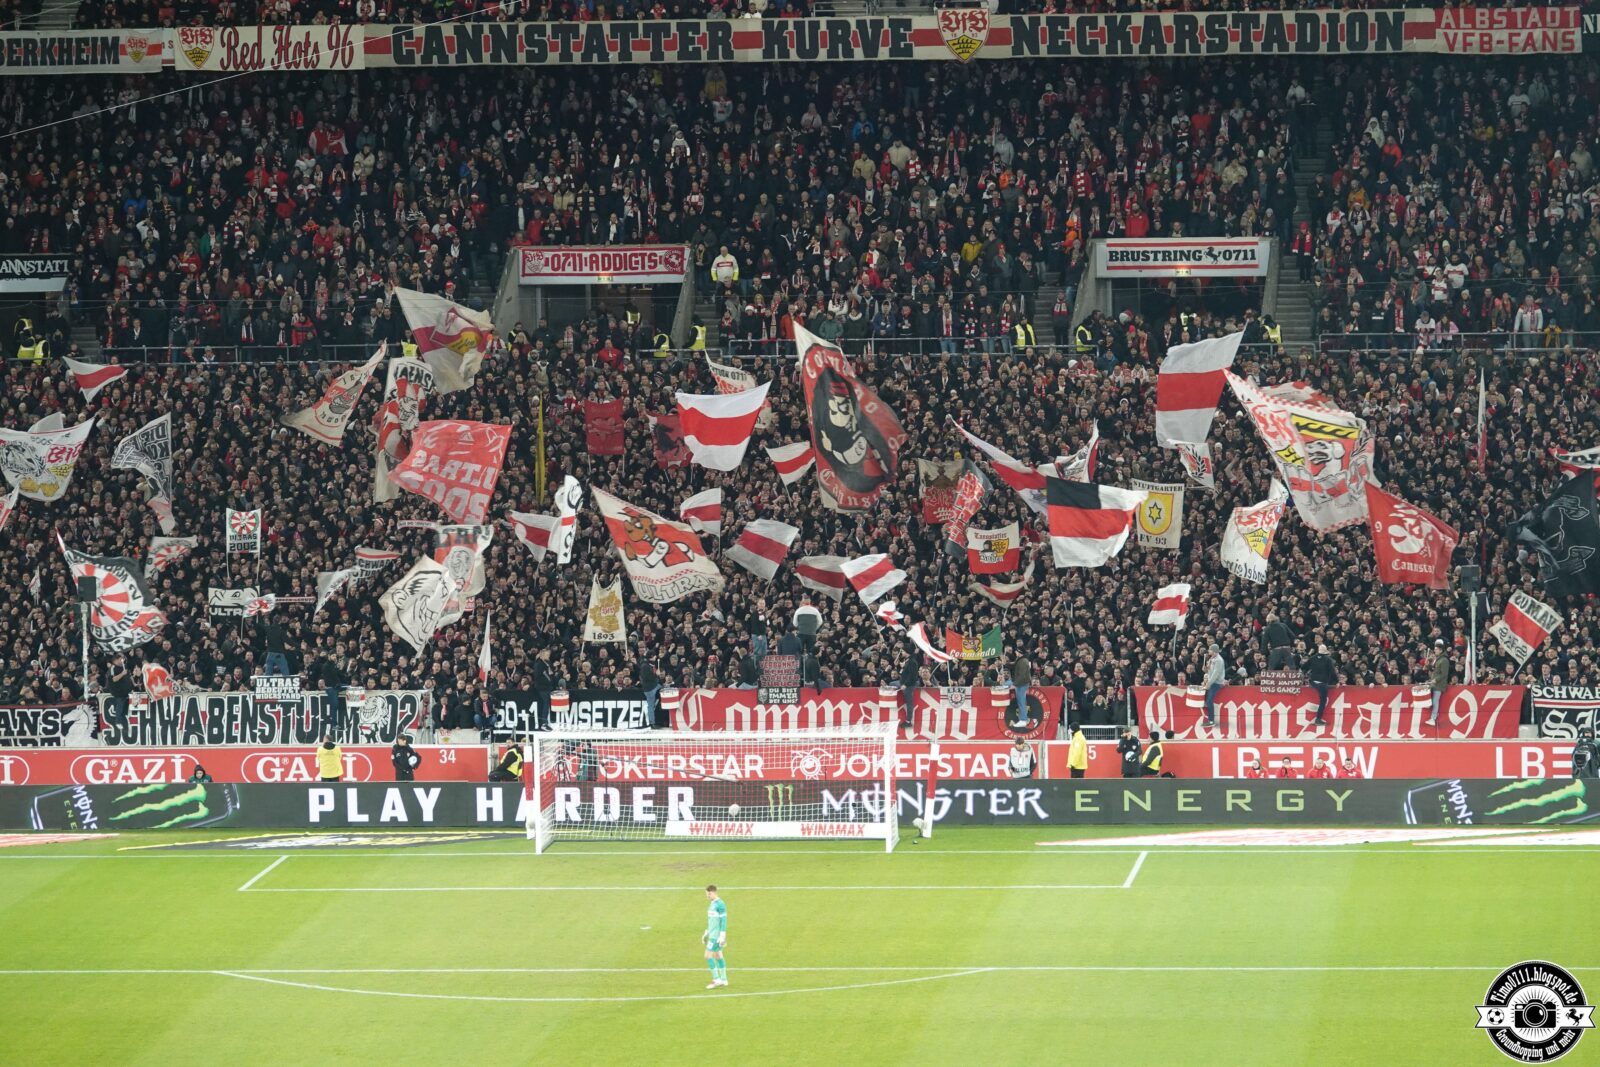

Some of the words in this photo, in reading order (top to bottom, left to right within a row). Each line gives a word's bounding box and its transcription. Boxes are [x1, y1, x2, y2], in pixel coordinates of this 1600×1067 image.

[1441, 7, 1577, 29] ALBSTADT
[392, 20, 734, 66] CANNSTATTER
[761, 17, 914, 60] KURVE
[1011, 9, 1405, 57] NECKARSTADION
[1444, 30, 1576, 53] VFB-FANS
[220, 26, 265, 70] Red
[271, 25, 321, 70] Hots
[329, 25, 354, 69] 96
[589, 251, 658, 271] ADDICTS
[1108, 249, 1203, 263] BRUSTRING
[1223, 248, 1257, 261] 0711
[1133, 480, 1183, 491] STUTTGARTER
[229, 542, 257, 551] 2002
[592, 632, 615, 640] 1893
[256, 678, 300, 687] ULTRAS
[1448, 689, 1513, 738] 97
[440, 749, 456, 764] 34
[600, 754, 764, 779] OKERSTAR
[309, 787, 441, 822] PLAY
[1075, 789, 1353, 812] ENERGY
[689, 822, 753, 836] WINAMAX
[800, 823, 866, 837] WINAMAX
